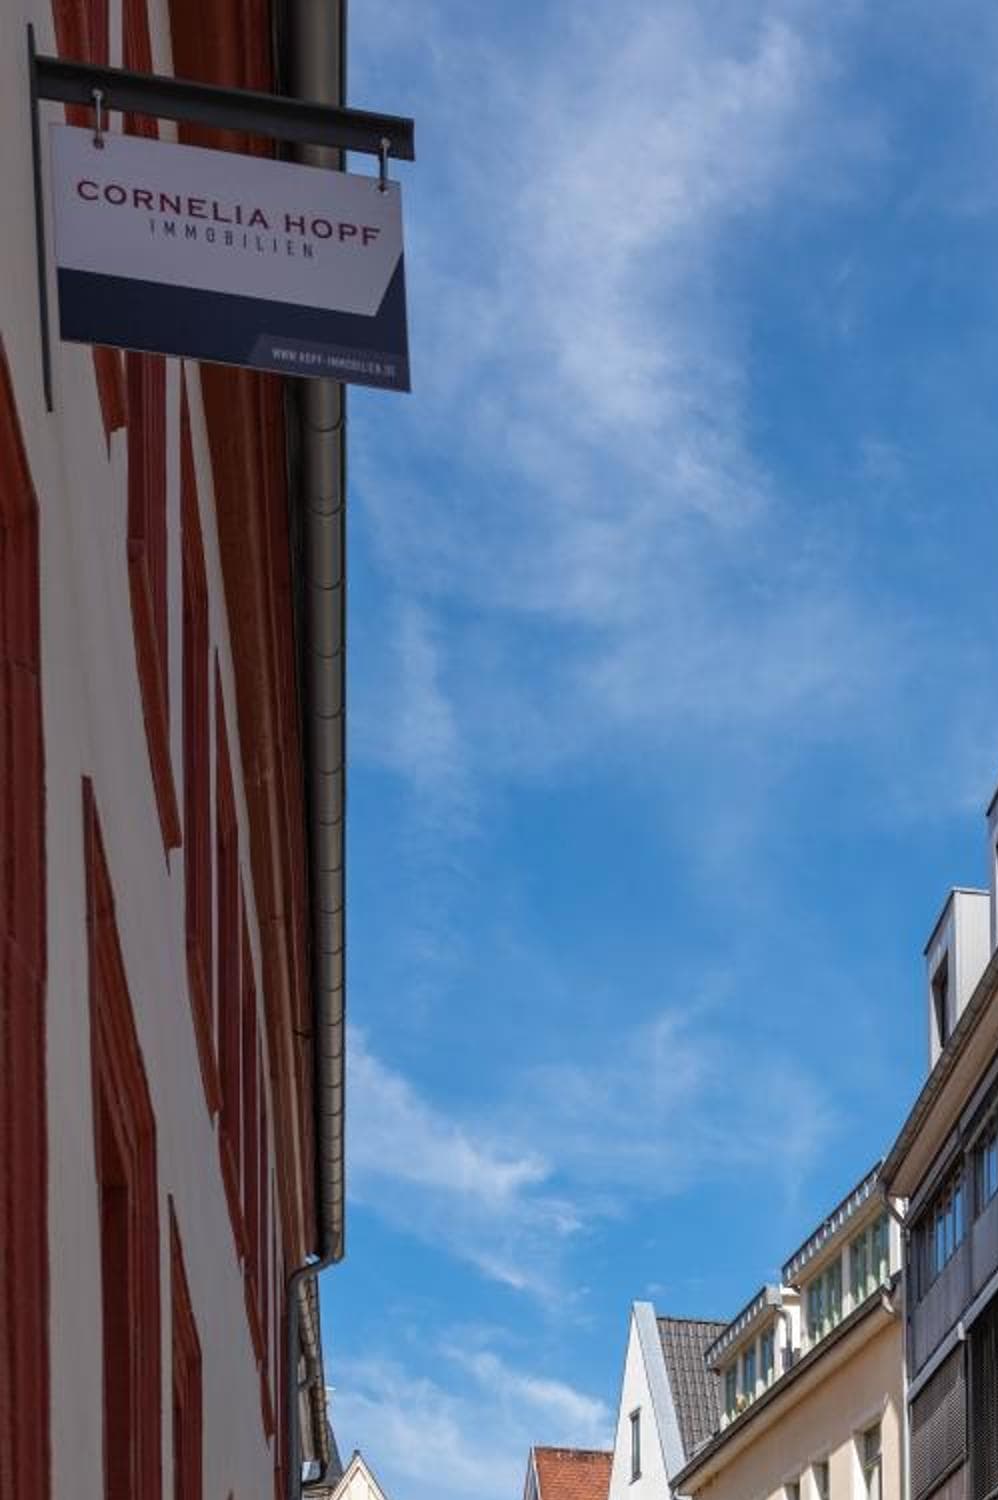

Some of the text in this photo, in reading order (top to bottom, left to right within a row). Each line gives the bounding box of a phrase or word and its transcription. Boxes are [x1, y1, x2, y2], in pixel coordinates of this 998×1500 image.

[77, 180, 381, 247] CORNELIA HOPF
[150, 218, 314, 258] IMMOBILIEN
